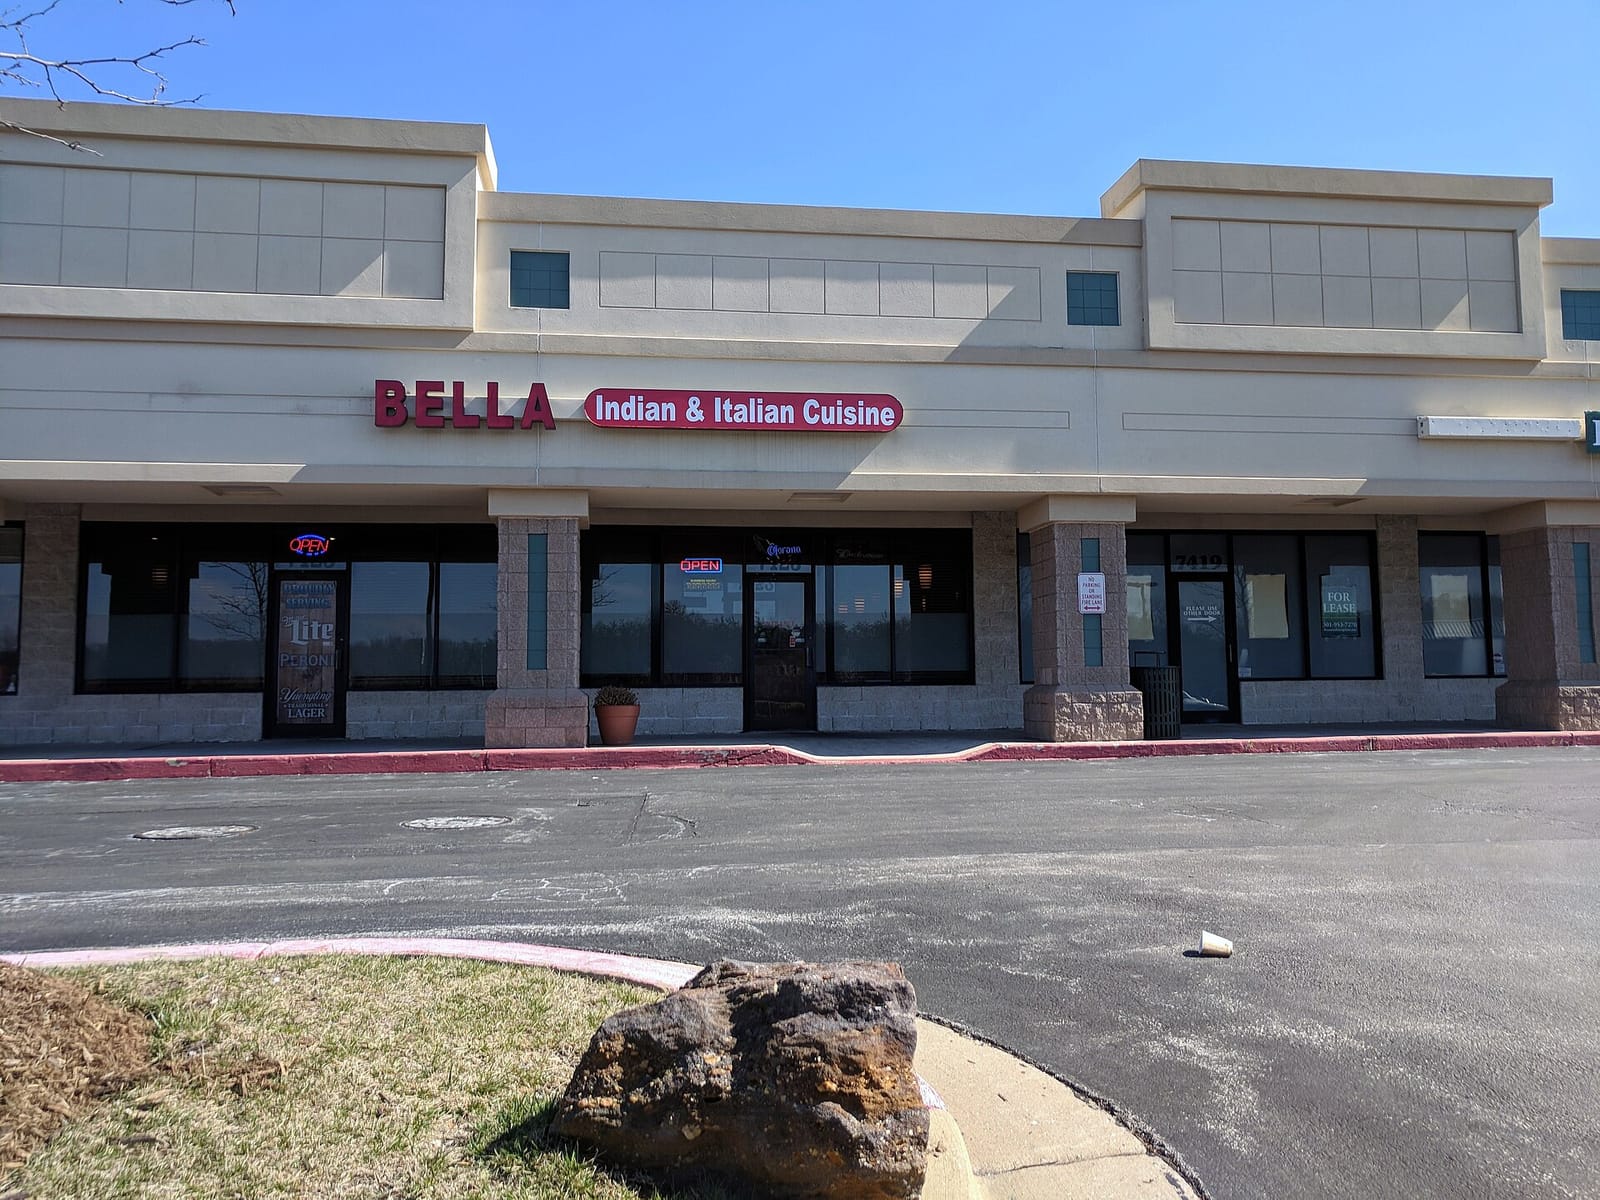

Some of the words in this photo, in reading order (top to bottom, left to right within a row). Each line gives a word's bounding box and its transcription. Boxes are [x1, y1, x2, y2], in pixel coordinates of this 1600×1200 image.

[375, 379, 556, 430] BELLA
[595, 394, 676, 422] Indian
[685, 396, 705, 423] &
[713, 396, 796, 424] Italian
[802, 398, 896, 426] Cuisine
[289, 538, 330, 552] OPEN
[767, 542, 802, 557] Corona
[680, 560, 720, 571] OPEN
[1176, 555, 1222, 569] 7419
[286, 597, 331, 608] SERVING
[1327, 591, 1351, 602] FOR
[1323, 603, 1357, 613] LEASE
[288, 619, 334, 646] Lite
[280, 653, 335, 667] PERONI
[287, 708, 325, 718] LAGER
